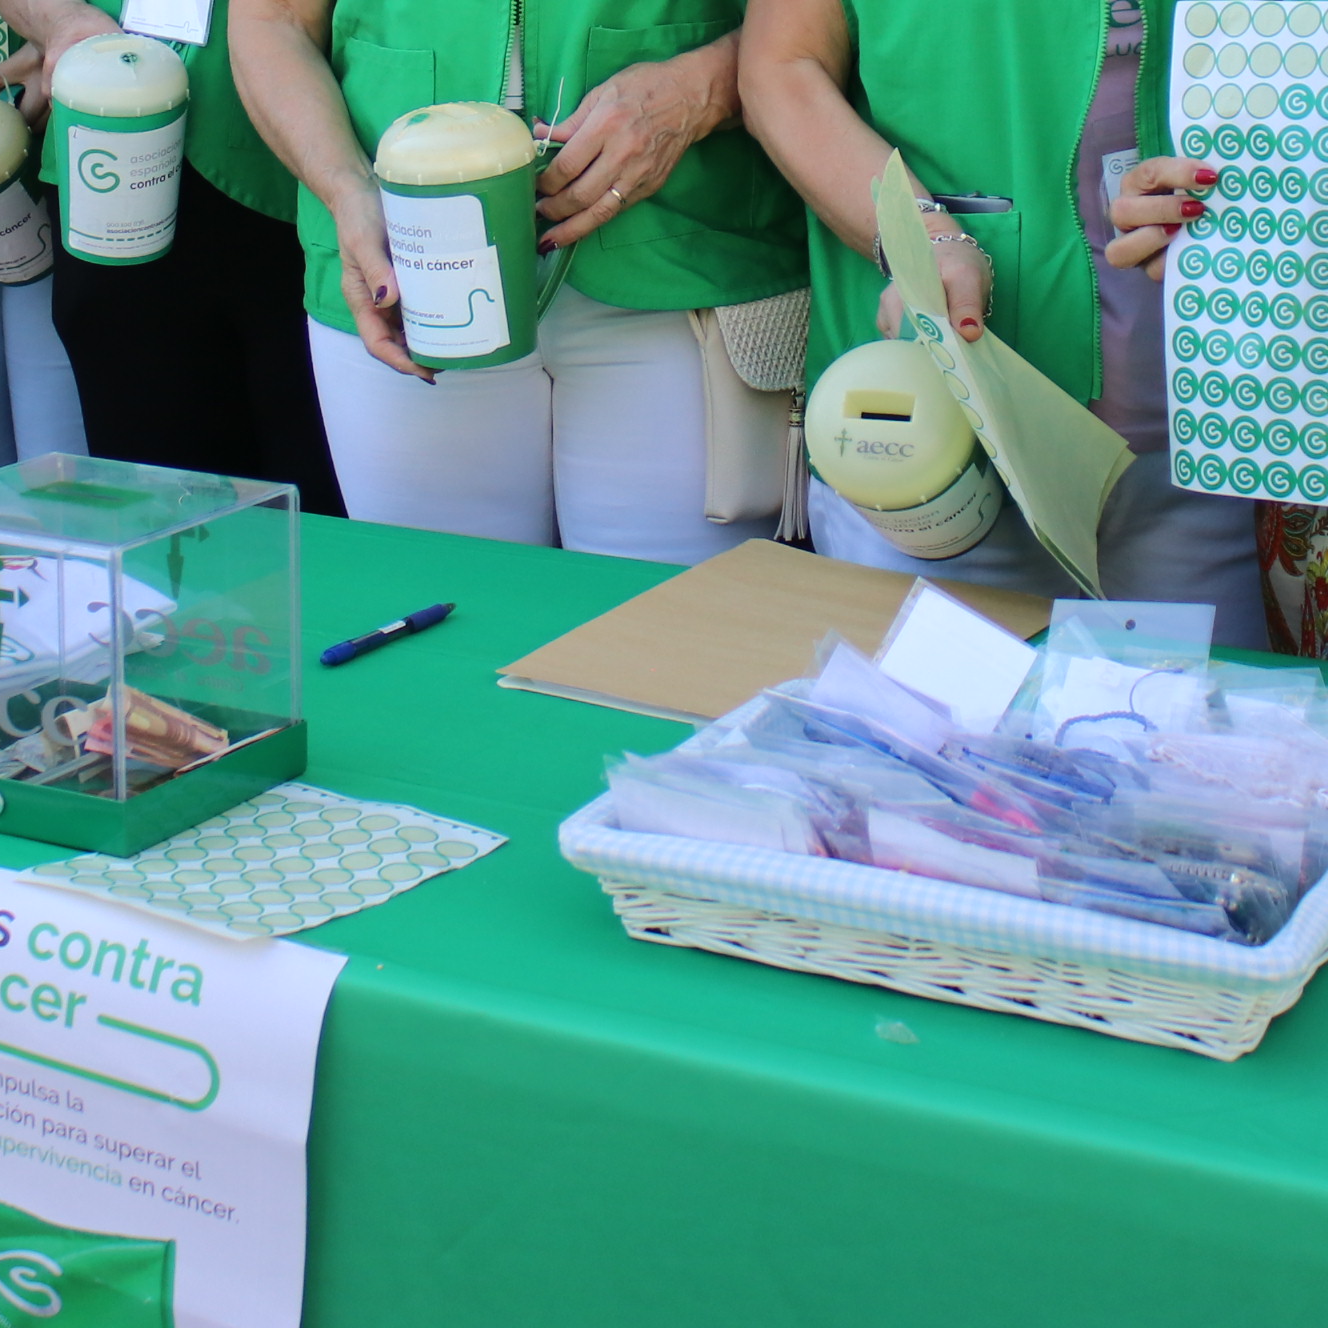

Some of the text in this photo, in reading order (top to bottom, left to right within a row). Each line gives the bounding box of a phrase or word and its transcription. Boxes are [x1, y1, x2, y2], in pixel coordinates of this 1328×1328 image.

[130, 155, 177, 177] española
[130, 166, 175, 190] contra el
[0, 213, 32, 236] cáncer
[414, 258, 474, 270] el cáncer
[856, 438, 915, 458] aecc
[27, 923, 205, 1007] contra
[66, 1088, 85, 1114] la
[41, 1116, 89, 1150] para
[93, 1130, 174, 1175] superar
[181, 1158, 203, 1181] el
[128, 1177, 156, 1198] en
[161, 1184, 241, 1224] cáncer.
